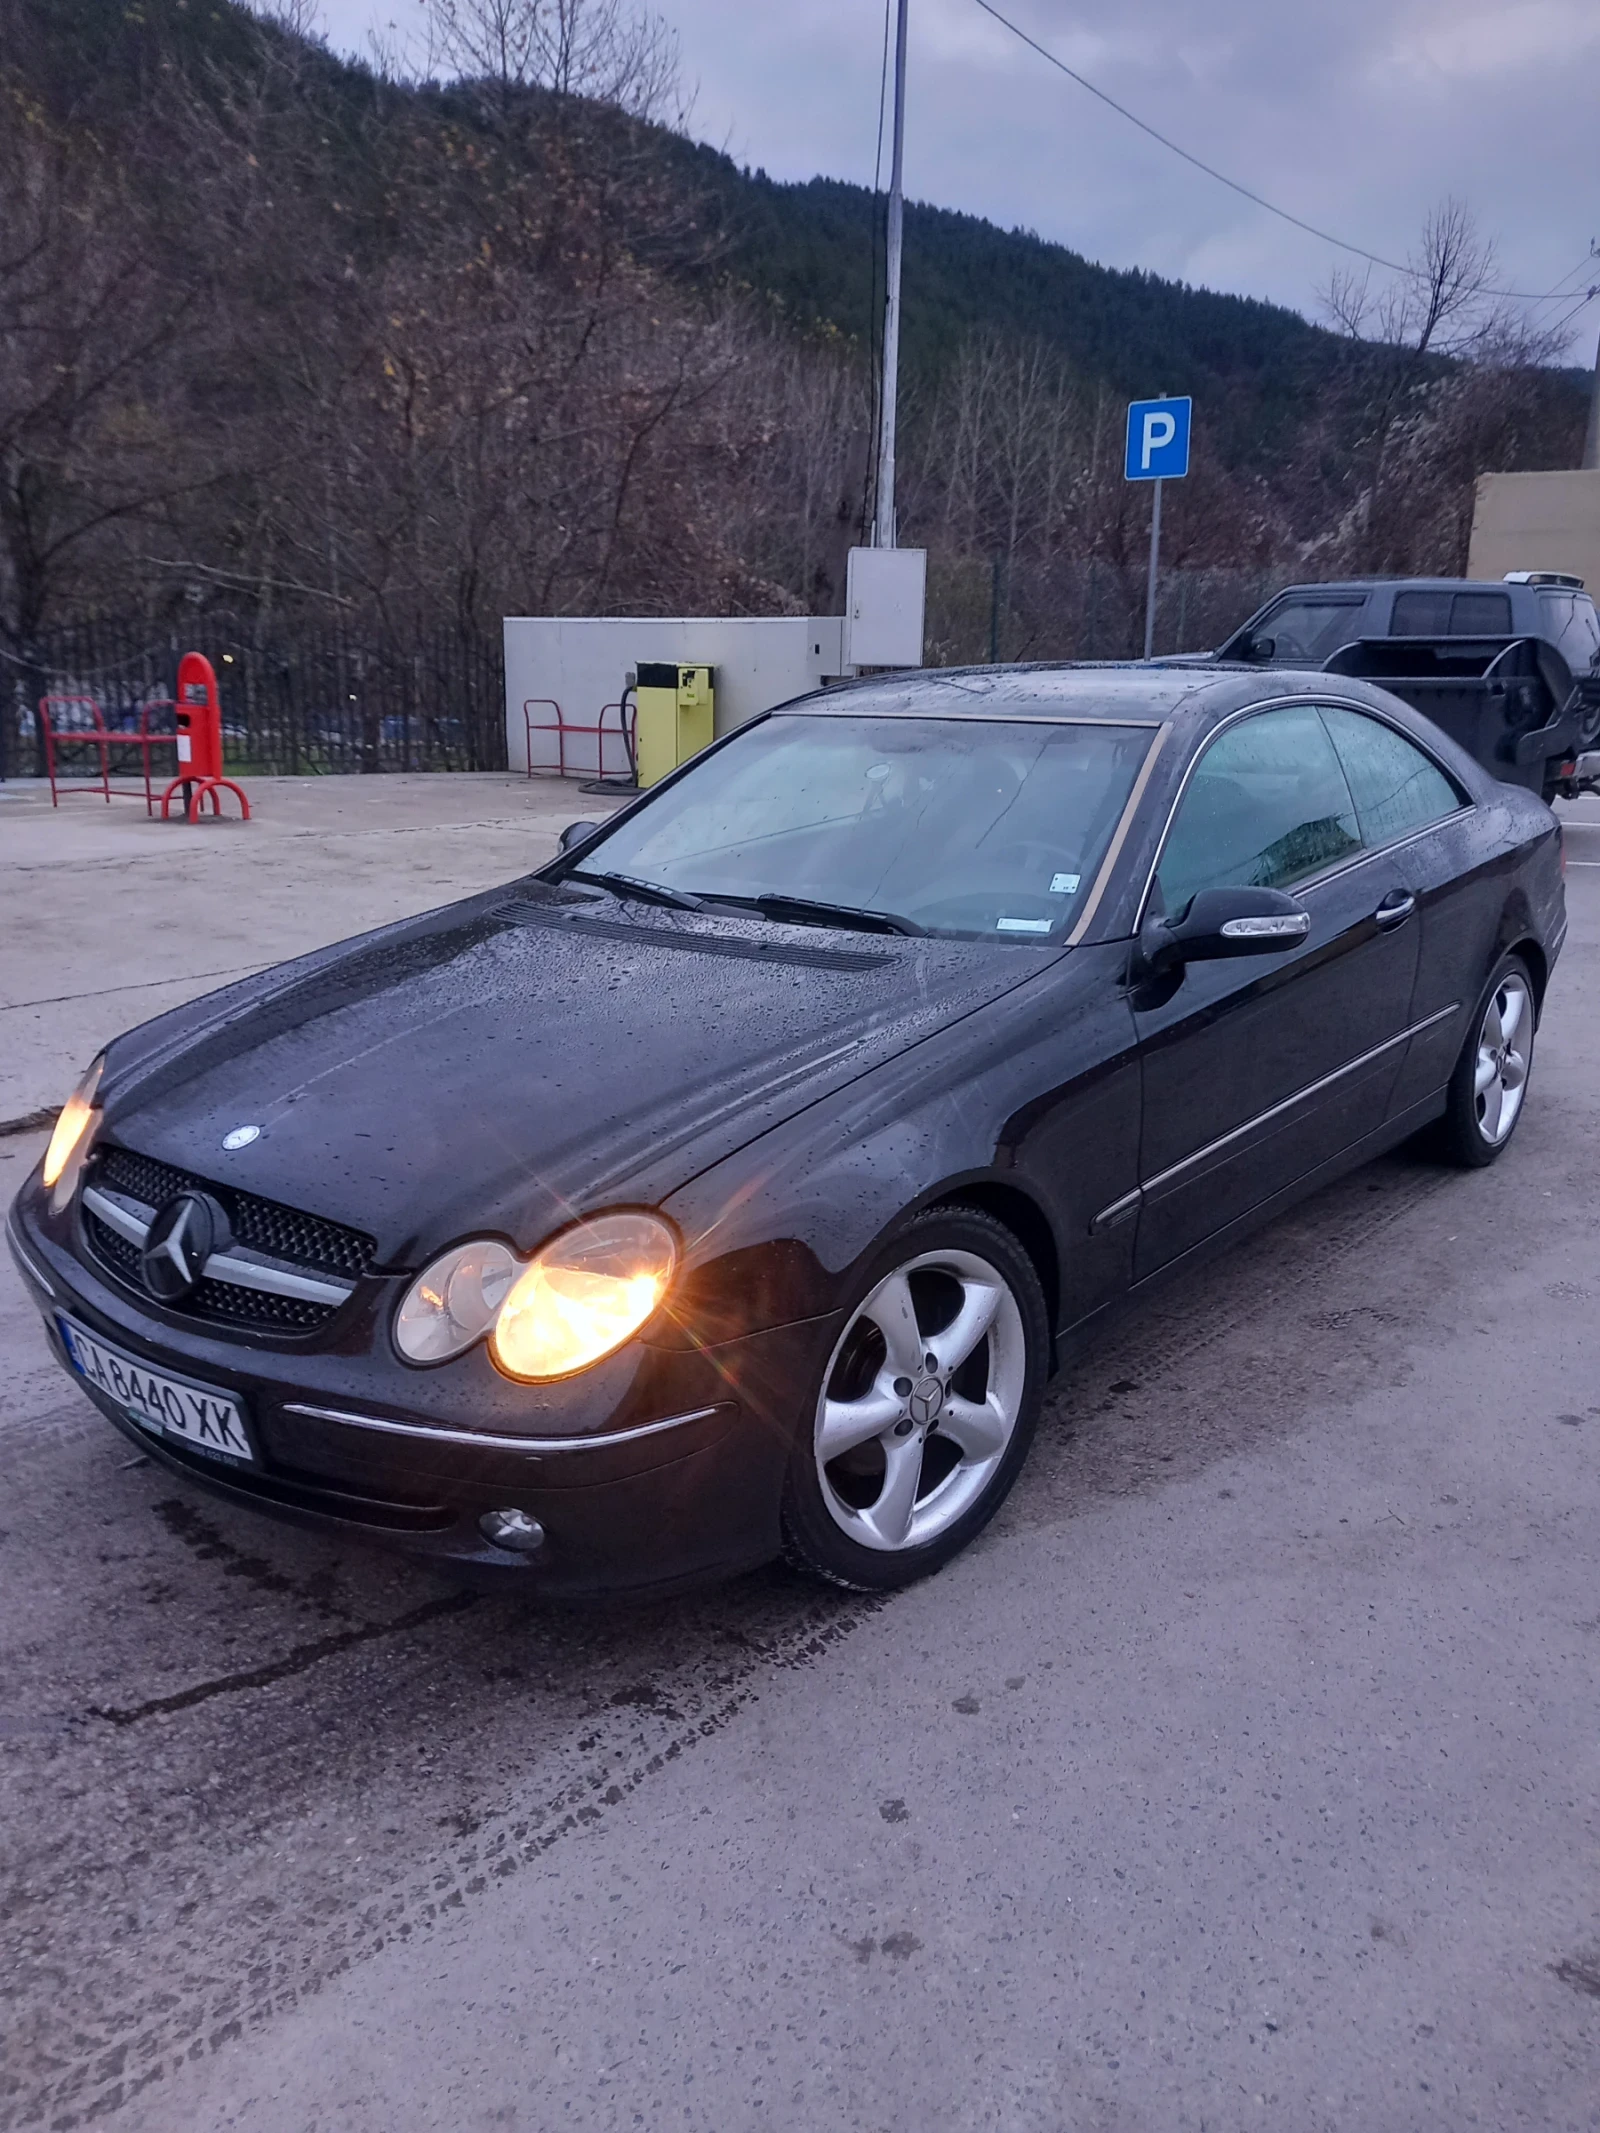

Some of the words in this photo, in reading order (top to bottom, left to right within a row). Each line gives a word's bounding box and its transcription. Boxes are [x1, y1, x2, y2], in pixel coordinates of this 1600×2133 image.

[1141, 411, 1176, 470] P
[109, 1358, 187, 1430] 8440
[186, 1393, 247, 1453] XK
